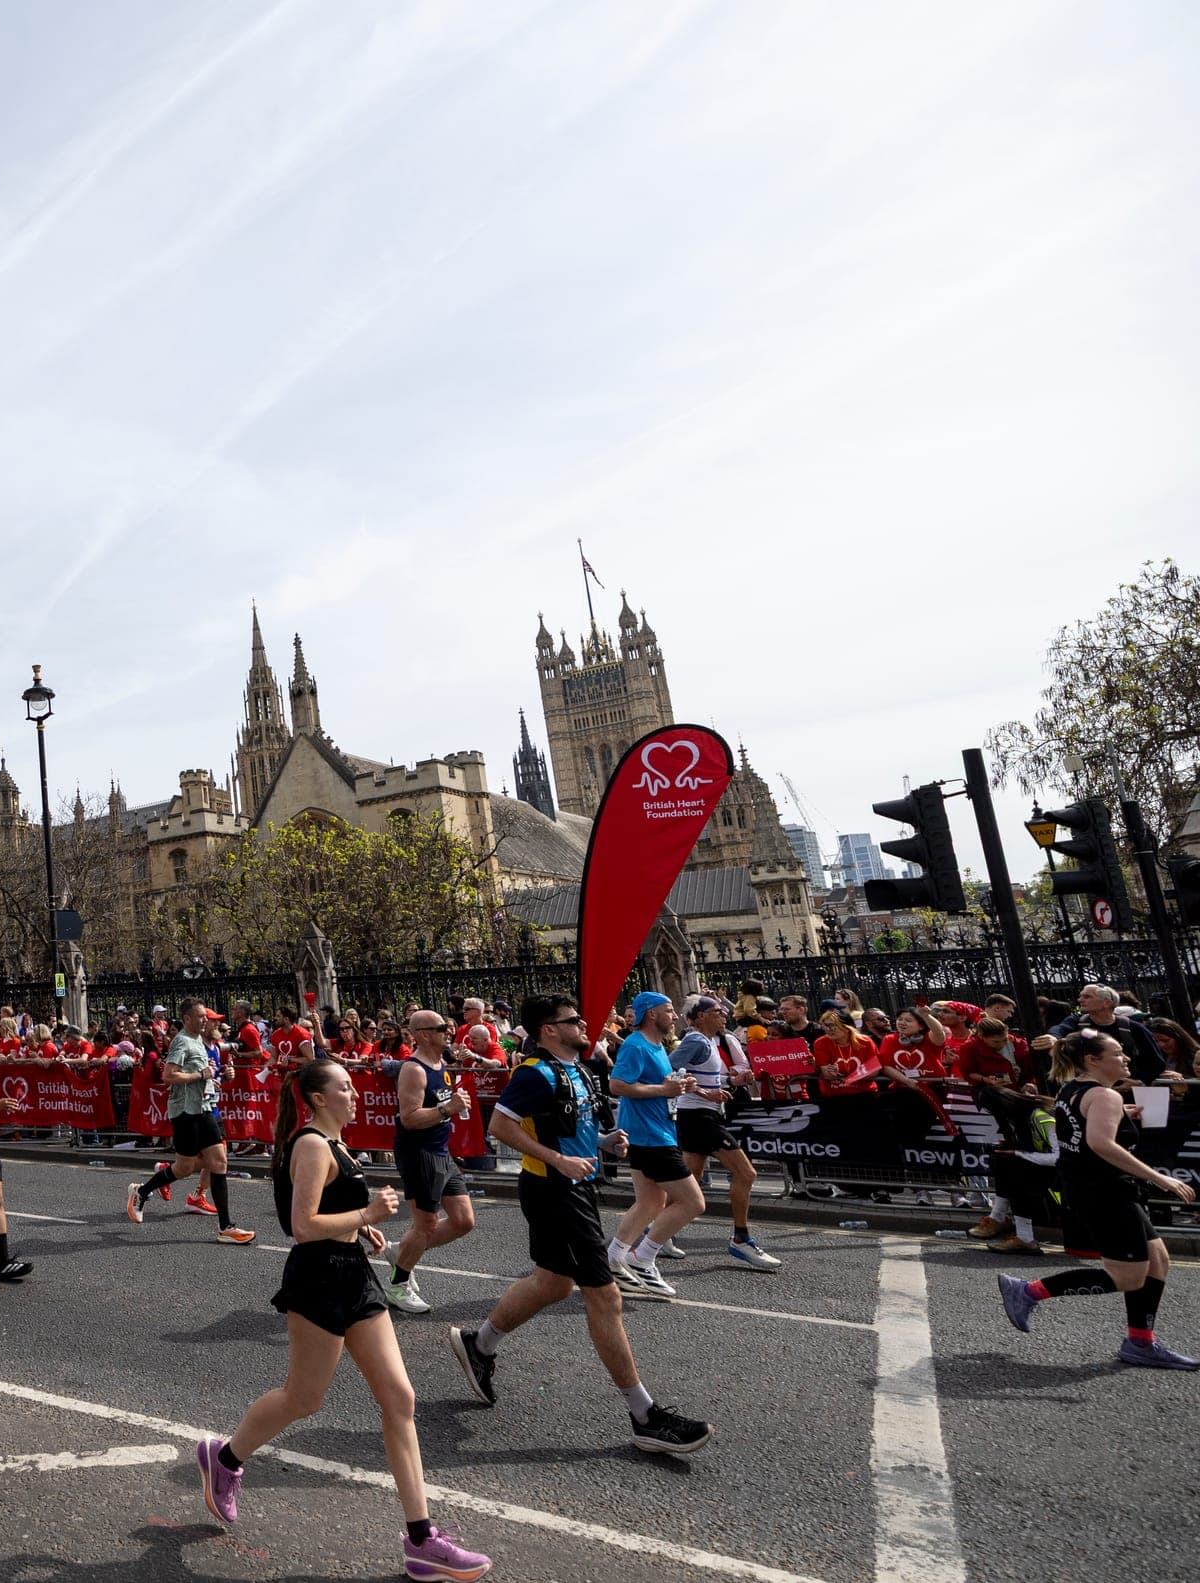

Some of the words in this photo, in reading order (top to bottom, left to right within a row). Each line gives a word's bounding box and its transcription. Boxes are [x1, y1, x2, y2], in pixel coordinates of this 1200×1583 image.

[643, 801, 675, 810] British
[677, 799, 706, 808] Heart
[646, 809, 704, 819] Foundation
[1034, 829, 1054, 837] TAXI
[38, 1081, 69, 1096] British
[232, 1088, 270, 1103] Heart
[38, 1097, 94, 1114] Foundation
[363, 1091, 399, 1106] Briti
[220, 1106, 263, 1121] dation
[747, 1136, 840, 1157] balance
[904, 1148, 956, 1167] new
